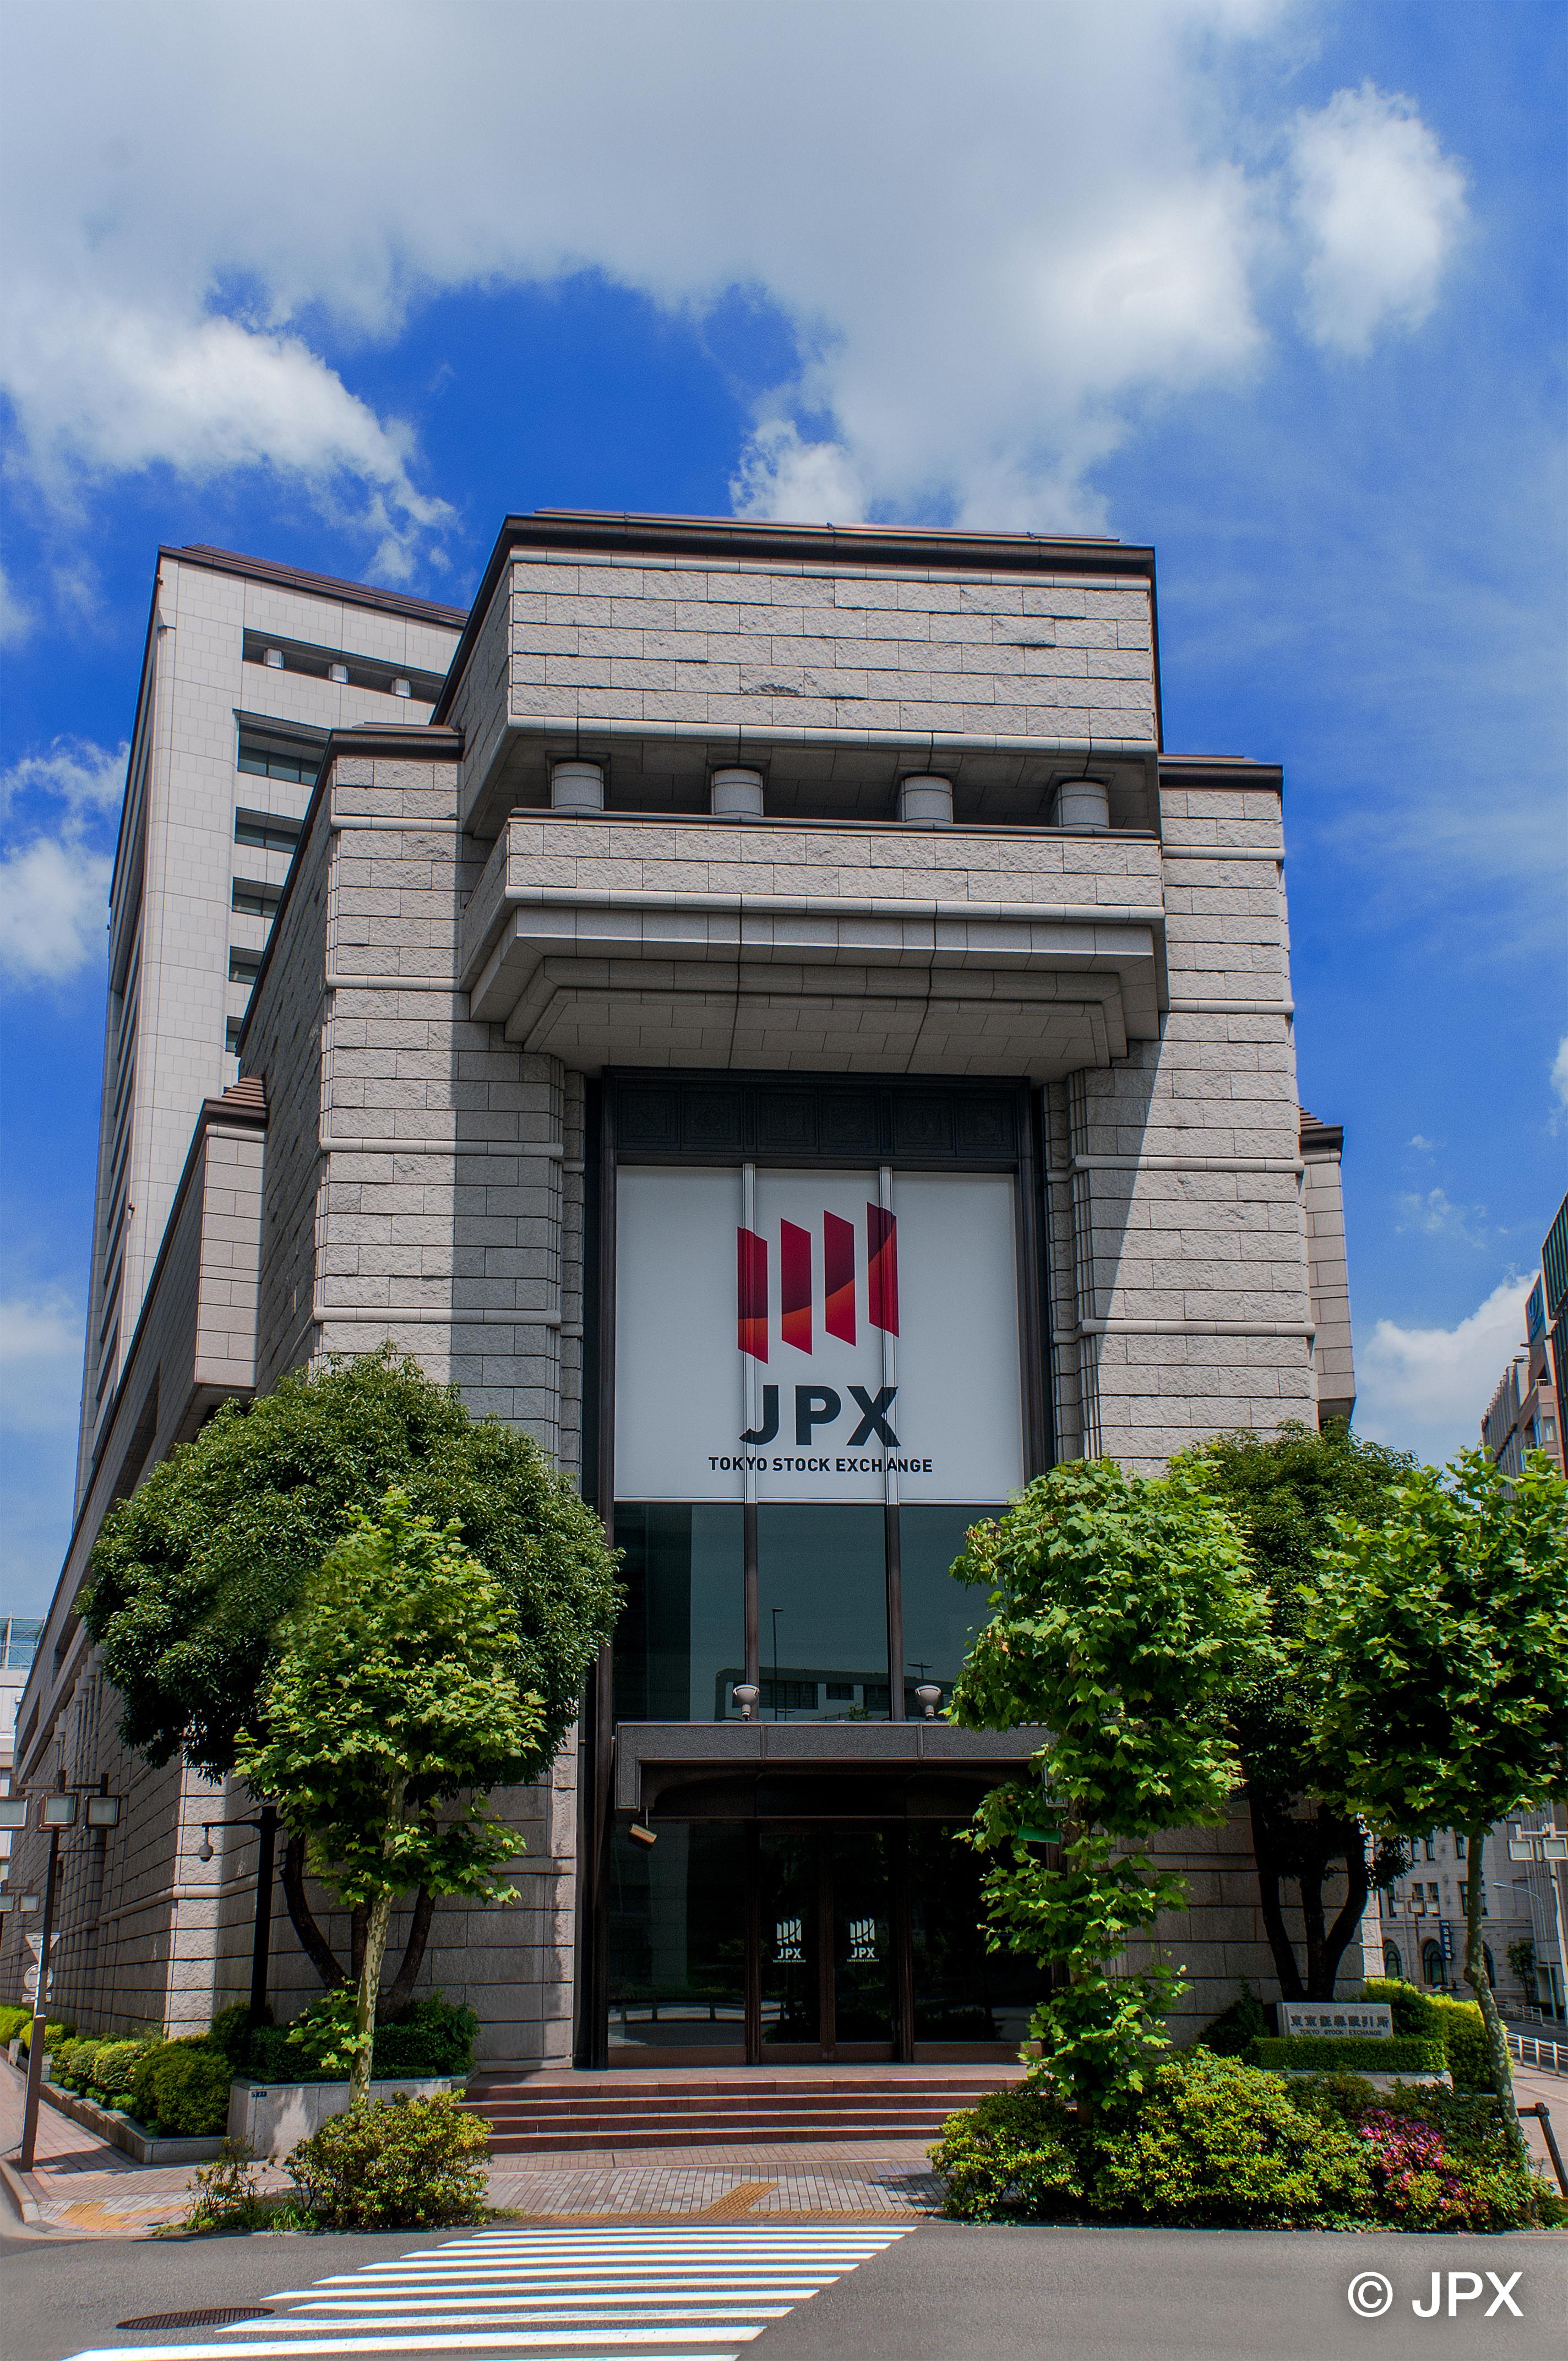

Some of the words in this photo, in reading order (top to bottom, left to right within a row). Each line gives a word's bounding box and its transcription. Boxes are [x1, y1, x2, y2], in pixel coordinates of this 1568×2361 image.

[738, 1384, 902, 1448] JPX
[708, 1456, 767, 1471] TOKYO
[772, 1457, 831, 1472] STOCK
[835, 1457, 933, 1473] EXCHANGE
[777, 1947, 802, 1959] JPX
[851, 1946, 875, 1959] JPX
[1290, 2014, 1389, 2027] 東京証券取引所
